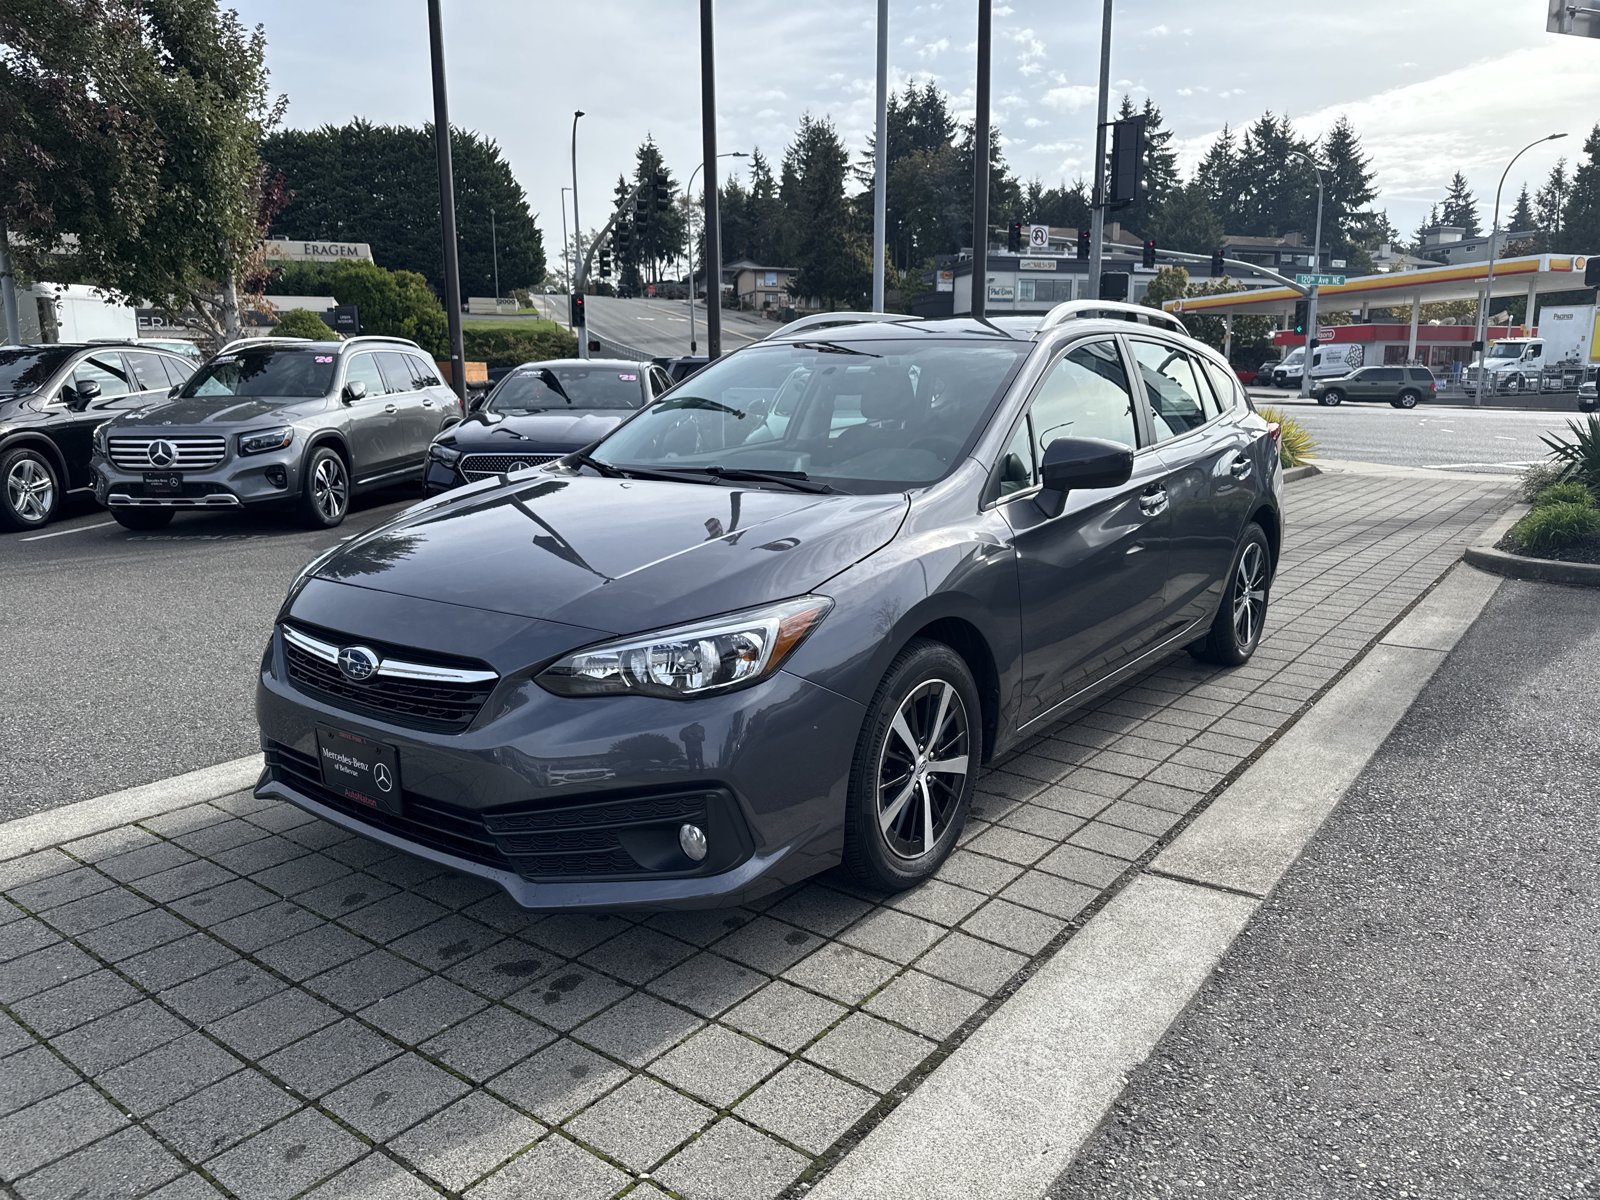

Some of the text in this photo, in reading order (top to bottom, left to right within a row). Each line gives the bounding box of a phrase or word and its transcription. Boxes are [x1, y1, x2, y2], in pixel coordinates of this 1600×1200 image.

[1301, 275, 1341, 284] 120th Ave NE
[322, 747, 369, 772] Mercedes-Benz
[340, 765, 358, 777] Bellevue
[345, 788, 377, 807] AutoNation
